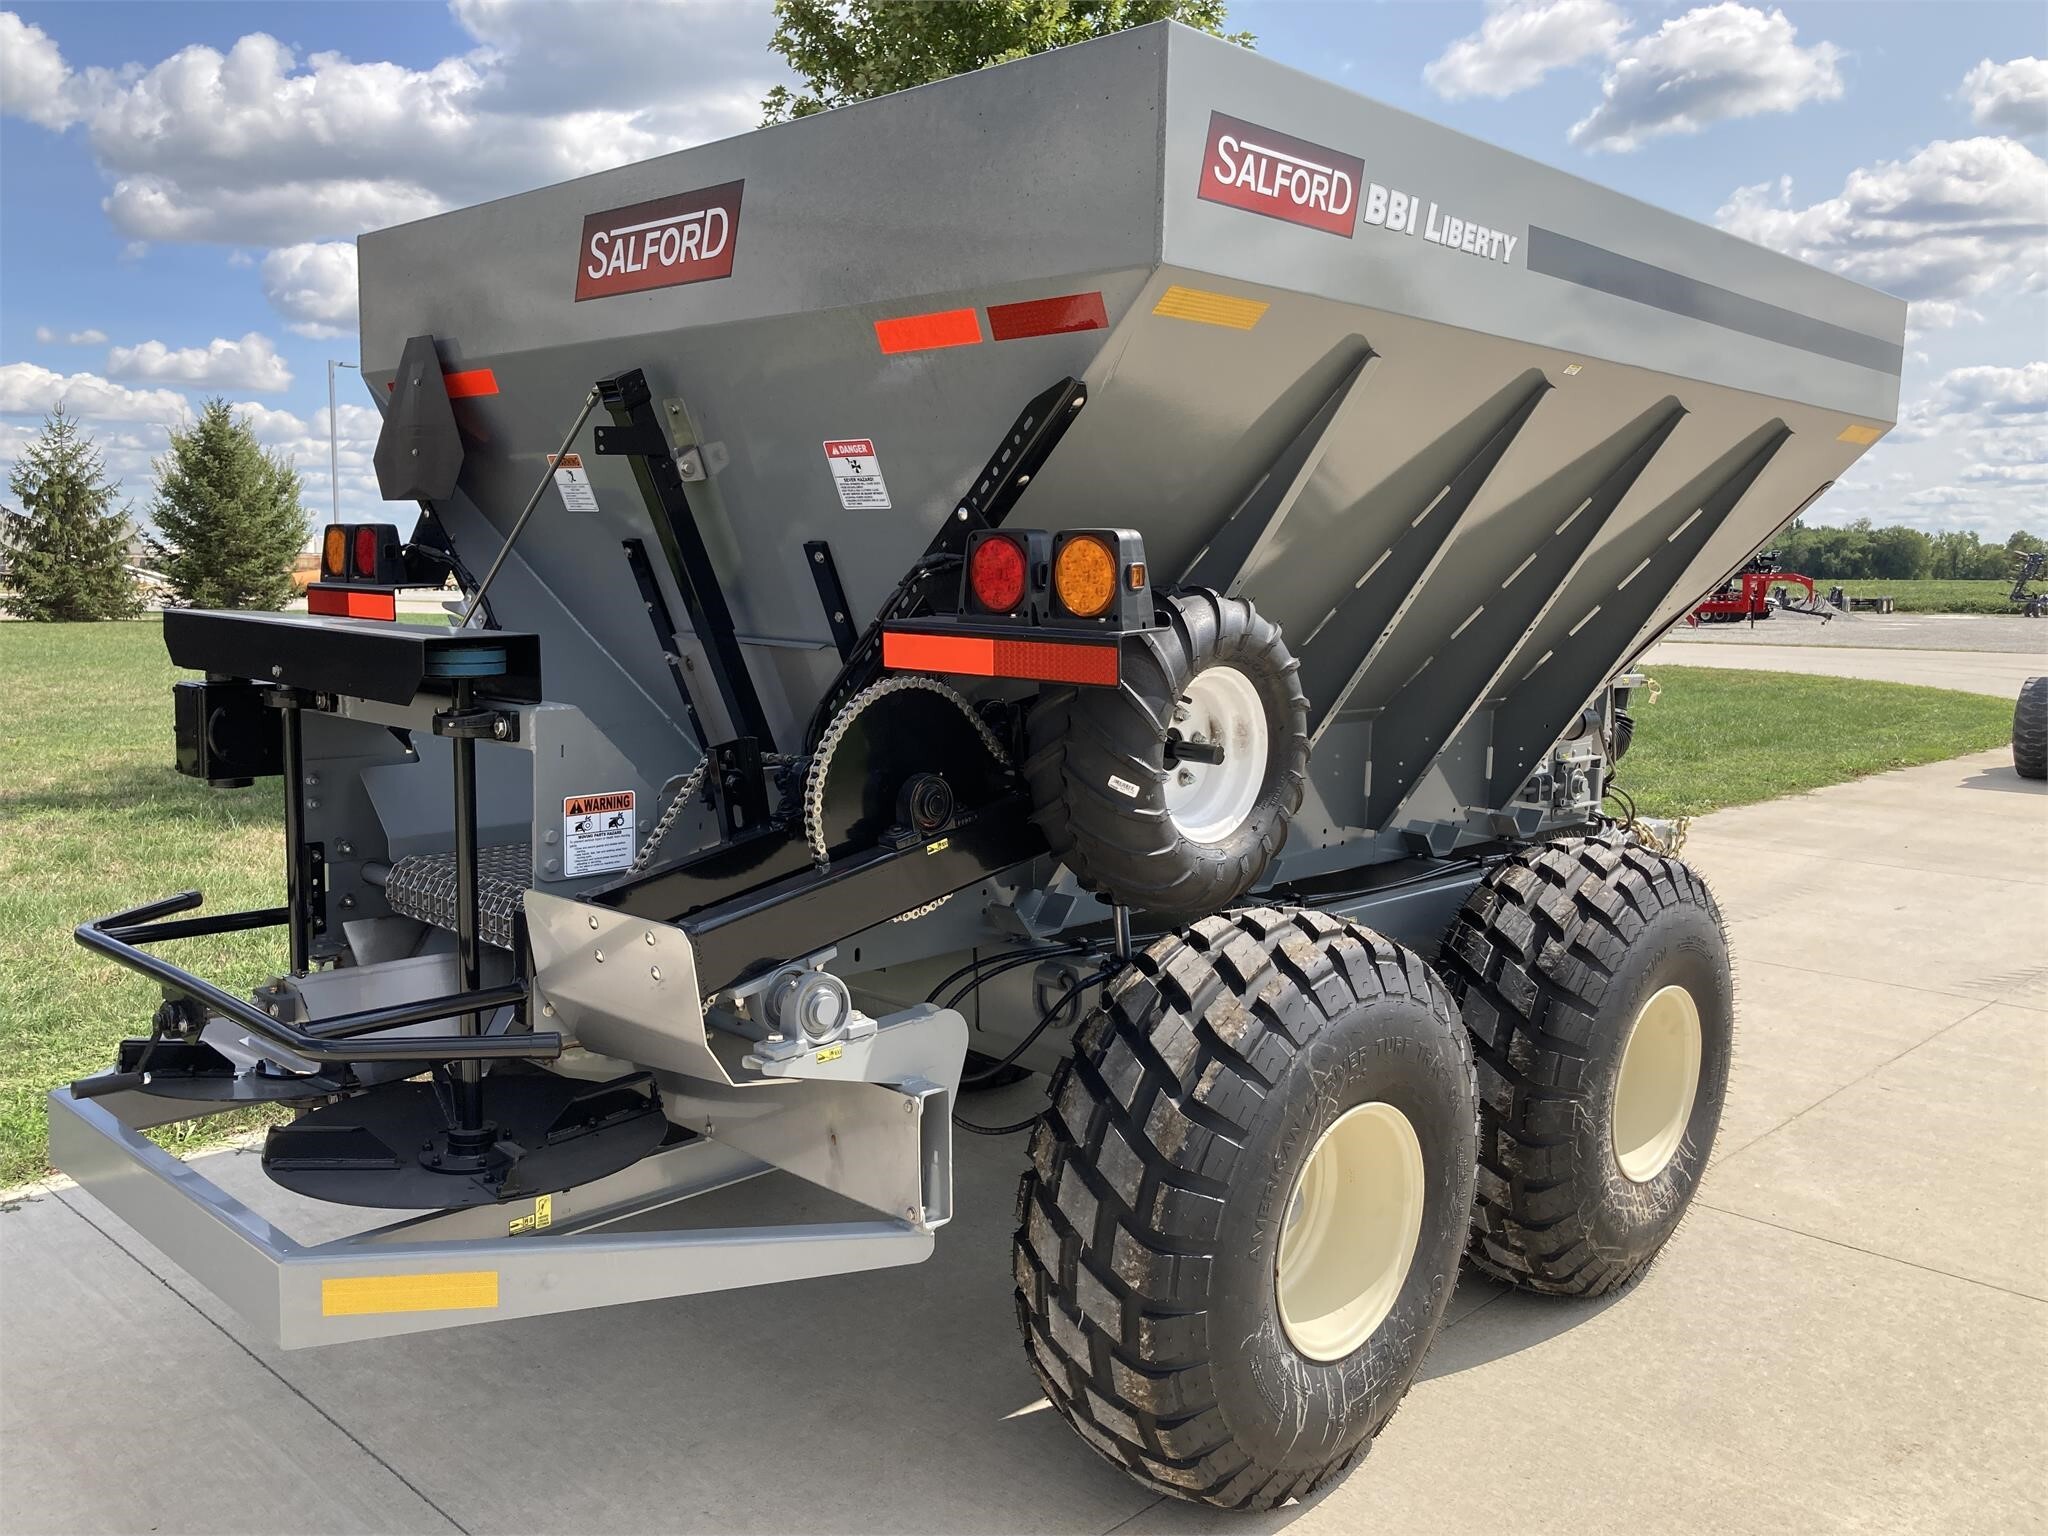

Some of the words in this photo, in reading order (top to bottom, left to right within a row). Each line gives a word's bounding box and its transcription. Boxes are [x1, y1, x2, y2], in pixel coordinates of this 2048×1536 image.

[1214, 135, 1352, 215] SALFORD
[587, 207, 729, 279] SALFORD
[1364, 182, 1420, 236] BBI
[1423, 201, 1518, 264] LIBERTY
[839, 444, 868, 454] DANGER
[583, 795, 630, 812] WARNING
